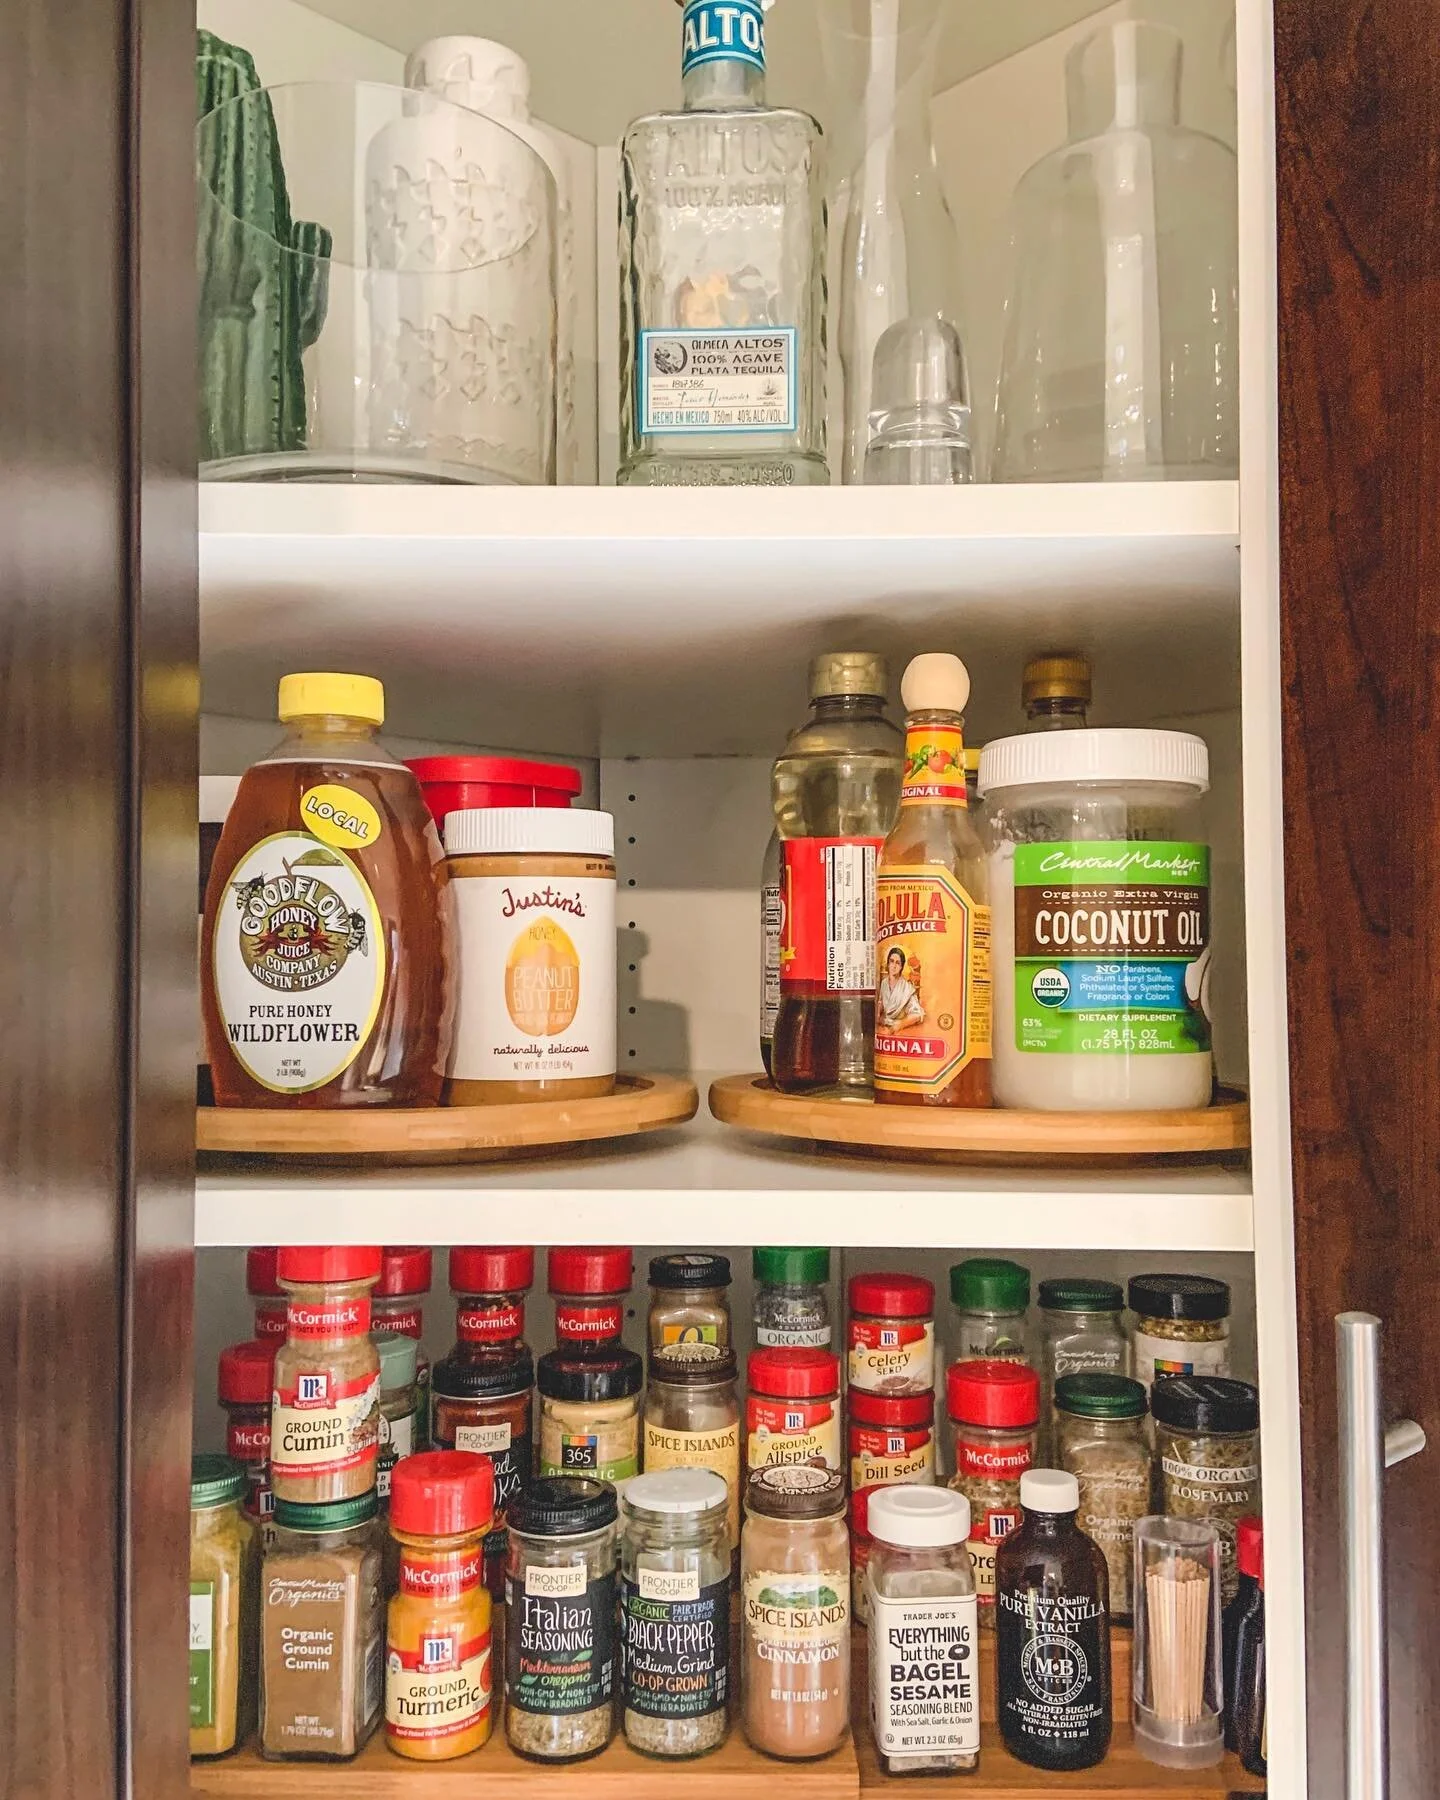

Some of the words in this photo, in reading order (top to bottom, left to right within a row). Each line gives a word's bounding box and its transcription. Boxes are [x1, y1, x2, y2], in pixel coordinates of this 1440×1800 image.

[734, 338, 783, 350] ALTOS
[692, 354, 727, 364] 100%
[732, 353, 783, 363] AGAVE
[691, 366, 729, 375] PLATA
[733, 365, 785, 375] TEQUILA
[652, 411, 673, 424] HECHO
[675, 411, 684, 424] EN
[684, 411, 710, 424] MEXICO
[306, 795, 369, 839] LOCAL
[1039, 851, 1128, 873] Central
[1125, 850, 1200, 872] Market
[501, 885, 586, 918] Justin's
[1042, 890, 1108, 900] Organic
[1113, 890, 1158, 899] Extra
[1163, 890, 1199, 900] Virgin
[241, 877, 350, 936] GOODFLOW
[270, 907, 320, 934] HONEY
[896, 920, 937, 934] SAUCE
[1035, 909, 1169, 945] COCONUT
[1177, 911, 1203, 945] OIL
[528, 927, 557, 941] HONEY
[277, 942, 311, 958] JUICE
[266, 954, 321, 974] COMPANY
[828, 946, 836, 989] Nutrition
[1095, 965, 1121, 973] NO
[251, 963, 292, 989] AUSTIN
[299, 959, 337, 988] TEXAS
[512, 966, 575, 988] PEANUT
[836, 962, 844, 989] Facts
[1040, 977, 1062, 987] USDA
[1081, 974, 1116, 982] Sodium
[1118, 974, 1145, 983] Lauryl
[1037, 989, 1065, 997] ORGANIC
[1080, 983, 1127, 992] Phthalates
[513, 988, 574, 1011] BUTTER
[1087, 993, 1130, 1002] Fragrance
[1145, 993, 1170, 1001] Colors
[249, 1005, 285, 1018] PURE
[287, 1004, 333, 1018] HONEY
[1078, 1014, 1119, 1022] DIETARY
[1122, 1014, 1177, 1022] SUPPLEMENT
[1022, 1018, 1042, 1027] 63%
[227, 1023, 360, 1042] WILDFLOWER
[1103, 1029, 1119, 1039] 28
[1122, 1029, 1138, 1039] FL
[1140, 1029, 1158, 1039] OZ
[493, 1043, 544, 1058] naturally
[547, 1043, 590, 1054] delicious
[1081, 1039, 1110, 1050] (1.75
[1114, 1039, 1135, 1050] PT)
[1139, 1039, 1175, 1049] 828mL
[281, 1059, 292, 1067] NET
[459, 1313, 518, 1329] McCormick
[558, 1316, 616, 1332] McCormick
[774, 1313, 821, 1325] McCormick
[316, 1325, 331, 1333] YOU
[767, 1332, 824, 1346] ORGANIC
[867, 1352, 911, 1368] Celery
[876, 1365, 902, 1376] SEED
[285, 1417, 342, 1433] GROUND
[283, 1430, 344, 1452] Cumin
[458, 1430, 506, 1441] FRONTIER
[648, 1430, 681, 1451] SPICE
[684, 1431, 736, 1452] ISLANDS
[771, 1435, 816, 1451] GROUND
[566, 1447, 592, 1464] 365
[765, 1445, 823, 1464] Allspice
[965, 1449, 1031, 1468] McCormick
[866, 1466, 889, 1480] Dill
[894, 1456, 925, 1477] Seed
[404, 1561, 479, 1584] McCormick
[529, 1572, 582, 1585] FRONTIER
[542, 1584, 568, 1592] CO-OP
[642, 1575, 694, 1589] FRONTIER
[269, 1587, 341, 1607] Organics
[1057, 1595, 1090, 1607] Quality
[521, 1596, 593, 1632] Italian
[629, 1598, 670, 1619] ORGANIC
[749, 1600, 786, 1628] SPICE
[790, 1600, 846, 1629] ISLANDS
[1000, 1591, 1037, 1617] PURE
[1037, 1600, 1106, 1622] VANILLA
[903, 1613, 933, 1621] TRADER
[935, 1612, 956, 1620] JOE'S
[1025, 1618, 1081, 1634] EXTRACT
[281, 1627, 334, 1643] Organic
[520, 1628, 594, 1651] SEASONING
[627, 1615, 666, 1652] BLACK
[667, 1620, 715, 1655] PEPPER
[889, 1625, 970, 1648] EVERYTHING
[282, 1643, 333, 1656] Ground
[757, 1643, 840, 1664] CINNAMON
[900, 1645, 924, 1662] but
[925, 1645, 945, 1660] the
[285, 1658, 330, 1670] Cumin
[520, 1657, 592, 1674] Mediterranean
[627, 1646, 676, 1675] Medium
[677, 1651, 715, 1674] Grind
[890, 1662, 970, 1682] BAGEL
[1038, 1676, 1073, 1684] SPICES
[409, 1678, 467, 1698] GROUND
[632, 1670, 664, 1691] CO-OP
[665, 1675, 708, 1692] GROWN
[520, 1687, 555, 1699] NON-GMO
[635, 1688, 671, 1702] NON-GMO
[890, 1683, 971, 1701] SESAME
[1026, 1678, 1041, 1694] SAN
[1042, 1681, 1084, 1704] FRANCISCO
[397, 1686, 480, 1716] Turmeric
[528, 1695, 593, 1708] NON-IRRADIATED
[640, 1700, 709, 1713] NON-IRRADIATED
[890, 1703, 943, 1716] SEASONING
[943, 1701, 973, 1714] BLEND
[1015, 1698, 1029, 1709] NO
[1029, 1704, 1063, 1714] ADDED
[1065, 1703, 1095, 1714] SUGAR
[1007, 1701, 1017, 1712] ALL
[1017, 1706, 1051, 1720] NATURAL
[1060, 1711, 1089, 1721] GLUTEN
[890, 1718, 906, 1727] With
[906, 1718, 918, 1726] Sea
[917, 1718, 931, 1727] Salt,
[931, 1717, 949, 1727] Garlic
[949, 1717, 955, 1725] &
[955, 1716, 973, 1725] Onion
[1022, 1716, 1088, 1728] NON-IRRADIATED
[1021, 1724, 1026, 1732] 4
[1027, 1726, 1037, 1735] fl.
[1038, 1728, 1051, 1737] OZ
[1062, 1729, 1078, 1738] 118
[1079, 1728, 1090, 1737] ml
[902, 1736, 915, 1745] NET
[926, 1736, 937, 1744] 2.3
[938, 1736, 946, 1744] OZ
